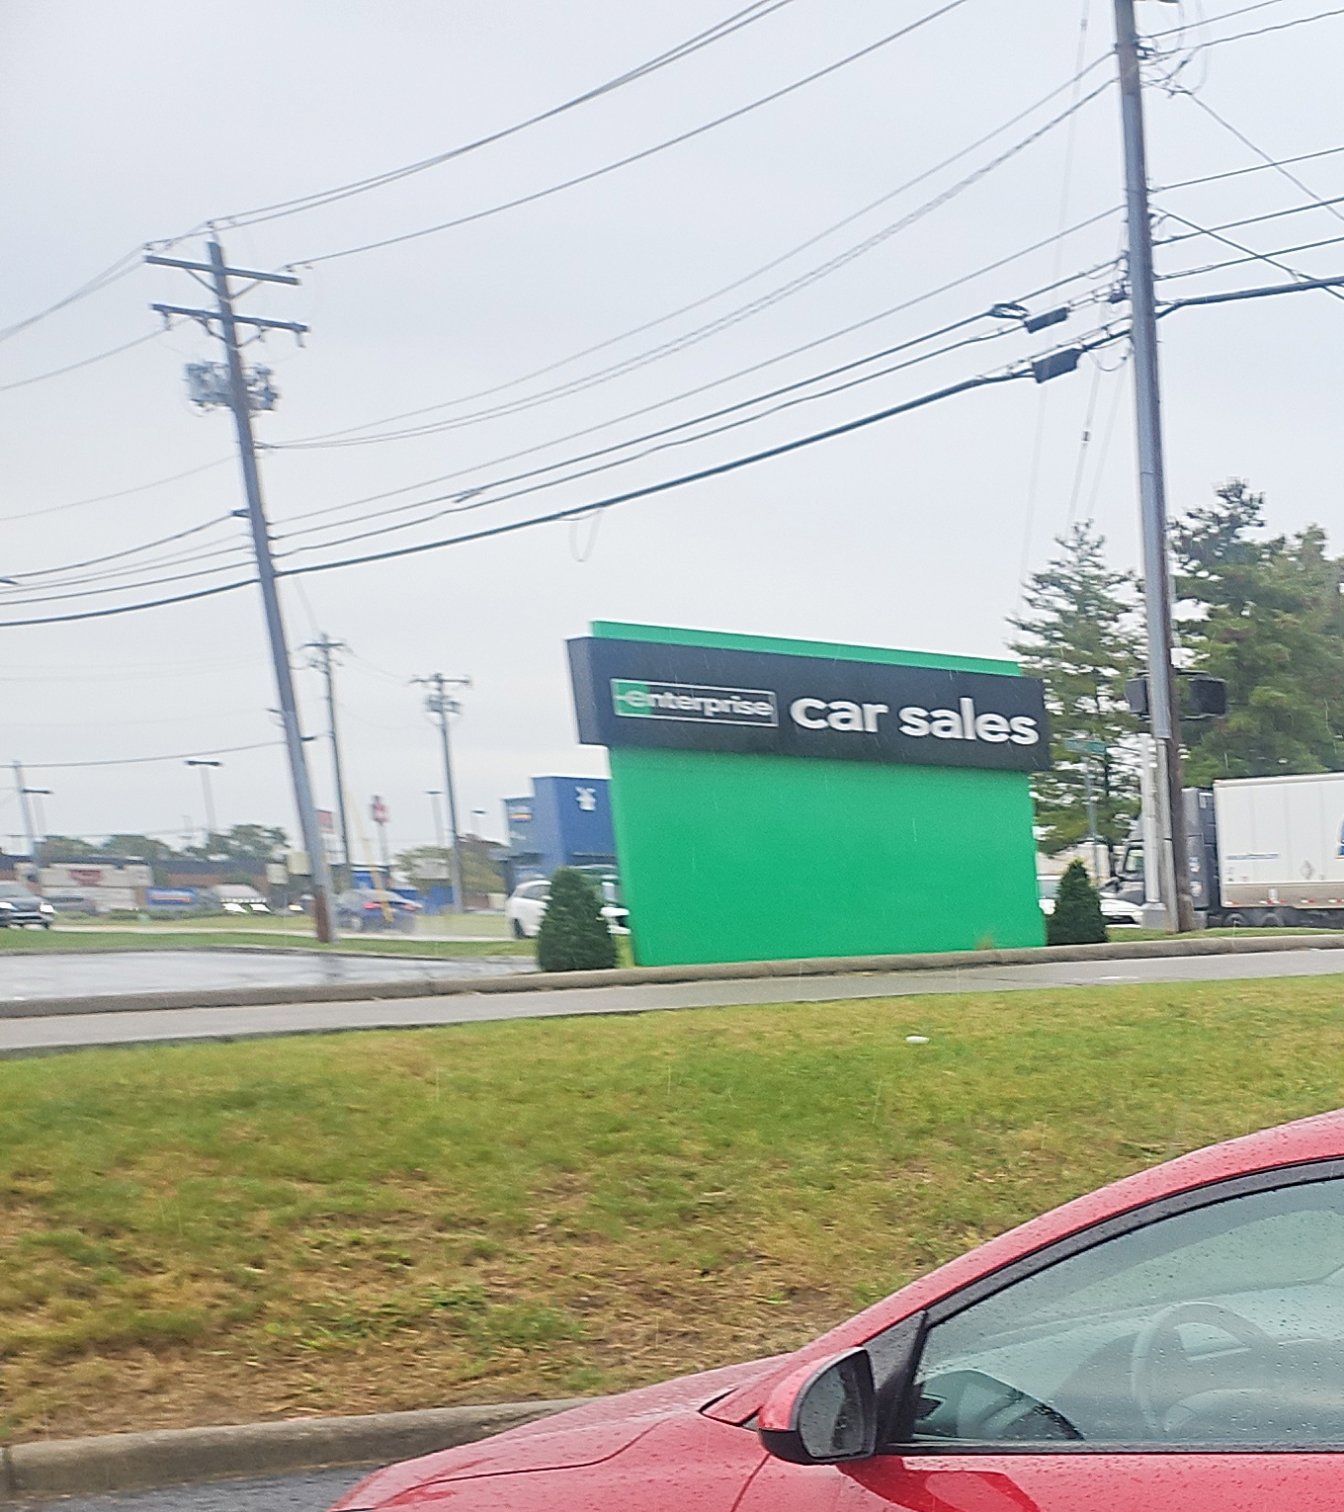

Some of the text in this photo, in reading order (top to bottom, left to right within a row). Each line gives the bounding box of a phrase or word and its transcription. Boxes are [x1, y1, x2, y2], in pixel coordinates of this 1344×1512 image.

[619, 690, 1040, 746] enterprise car sales
